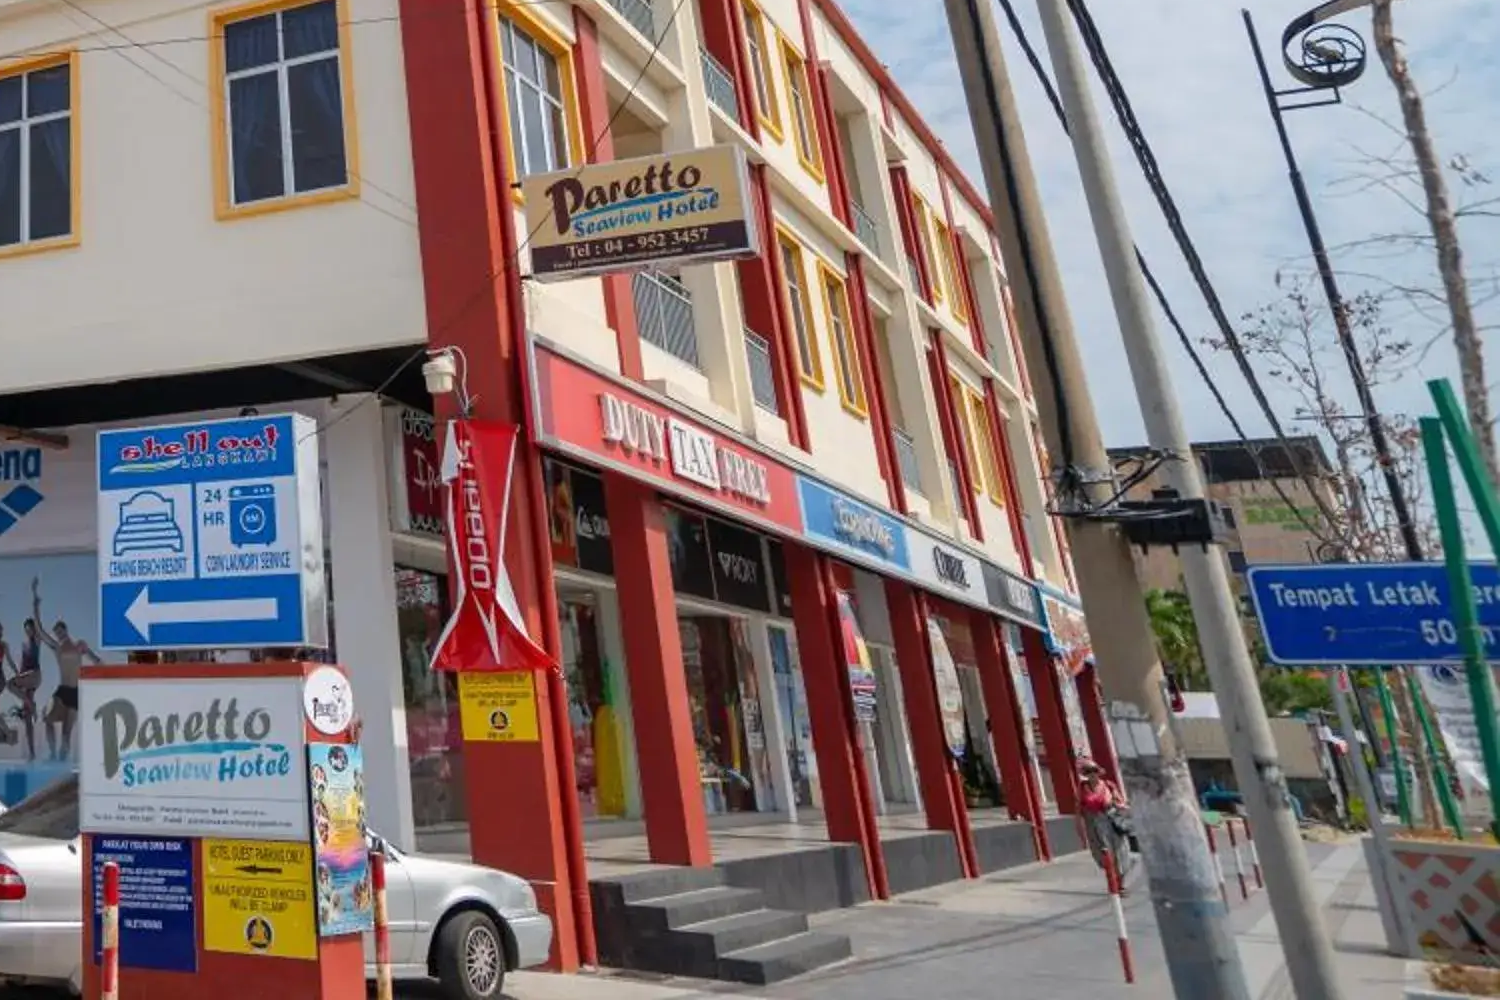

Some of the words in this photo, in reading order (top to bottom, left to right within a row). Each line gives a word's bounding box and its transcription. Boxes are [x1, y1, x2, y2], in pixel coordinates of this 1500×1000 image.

[545, 161, 701, 235] Paretto
[573, 209, 652, 238] Seaview
[657, 191, 719, 222] Hotel
[566, 244, 591, 259] Tel
[605, 240, 623, 255] 04
[637, 233, 667, 250] 952
[671, 227, 710, 245] 3457
[121, 430, 210, 462] shell
[217, 424, 281, 451] out
[598, 392, 667, 462] DUTY
[673, 424, 717, 483] TAX
[716, 446, 772, 505] FREE
[204, 489, 222, 503] 24
[203, 510, 226, 527] HR
[261, 551, 291, 570] SERVICE
[1268, 582, 1359, 610] Tempat
[1366, 579, 1442, 606] Letak
[1420, 618, 1457, 645] 50
[94, 697, 271, 779] Paretto
[123, 759, 213, 787] Seaview
[218, 752, 290, 782] Hotel
